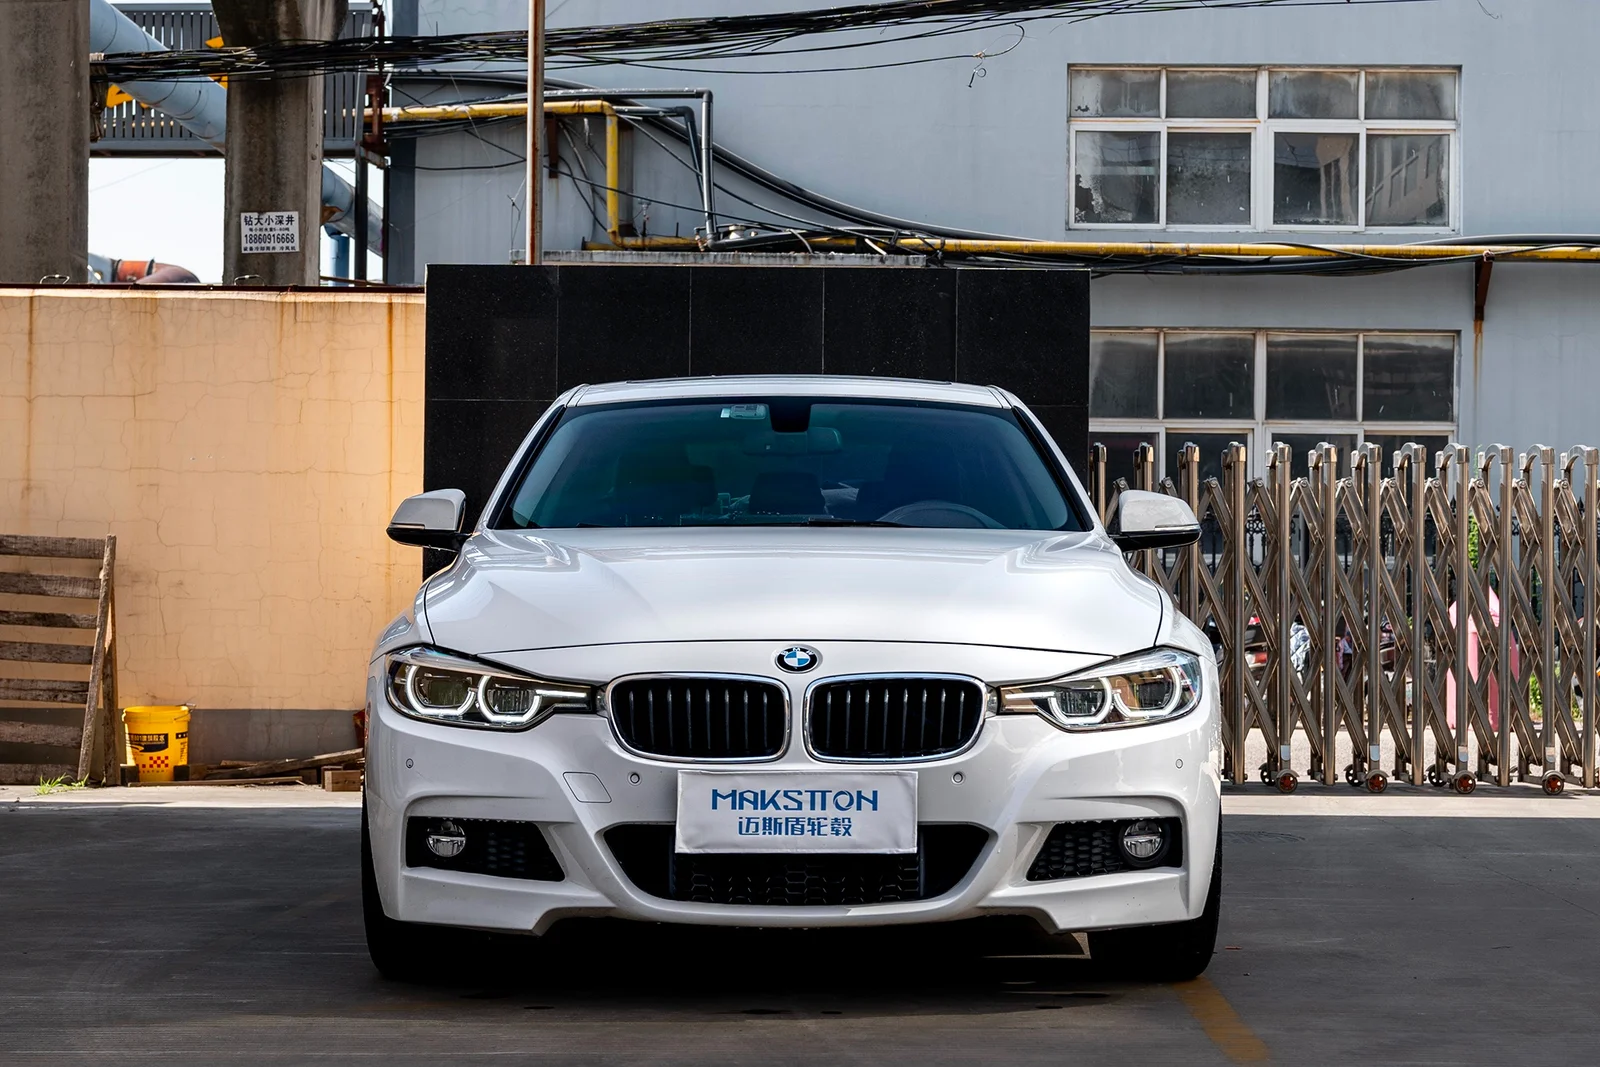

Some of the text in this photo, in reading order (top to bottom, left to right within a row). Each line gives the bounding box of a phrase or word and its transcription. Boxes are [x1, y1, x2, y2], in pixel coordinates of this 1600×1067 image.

[244, 214, 295, 226] 钻大小深井
[244, 233, 295, 244] 18860916668
[780, 647, 816, 655] BMW
[711, 788, 879, 811] MAKSTTON
[738, 816, 853, 837] 迈斯盾轮毂
